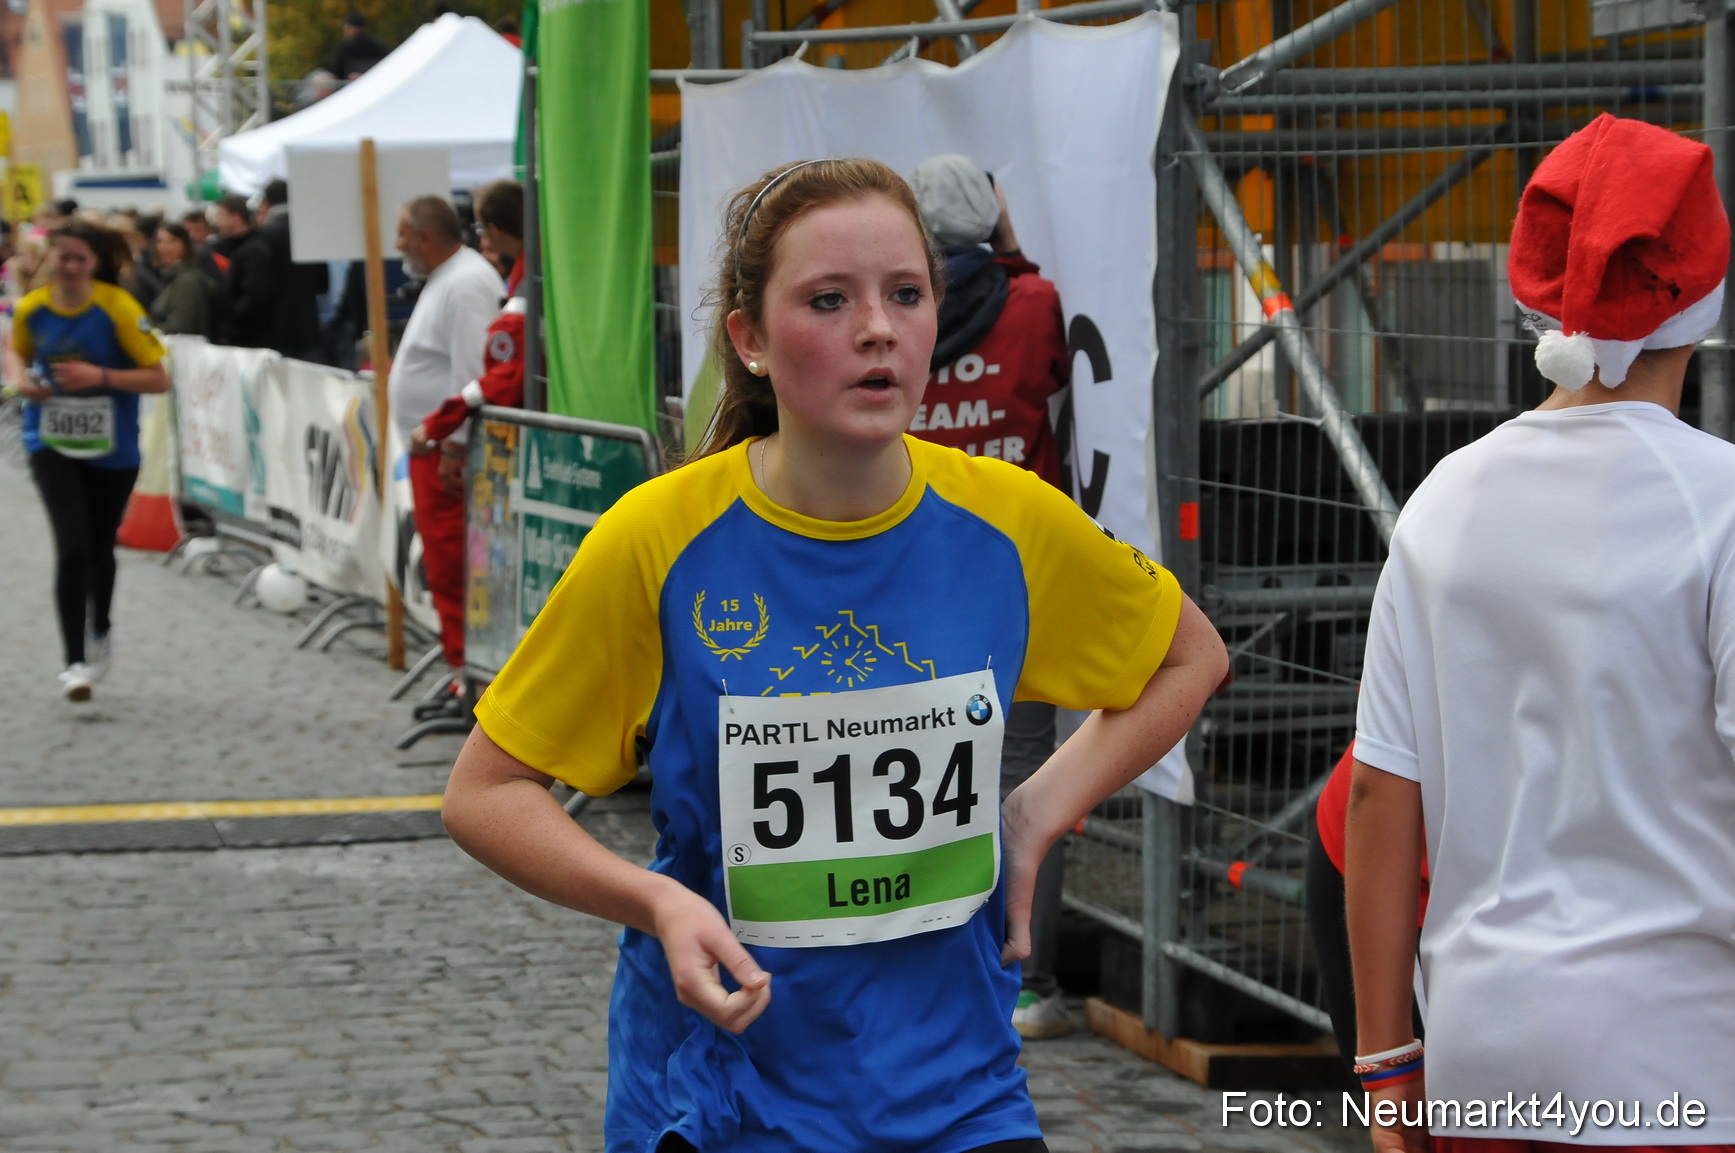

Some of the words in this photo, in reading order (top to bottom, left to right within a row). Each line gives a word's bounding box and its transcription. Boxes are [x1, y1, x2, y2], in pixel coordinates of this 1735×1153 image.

[720, 599, 740, 612] 15
[709, 618, 753, 633] Jahre
[725, 721, 819, 746] PARTL
[826, 706, 956, 740] Neumarkt
[752, 740, 978, 850] 5134
[826, 872, 911, 908] Lena
